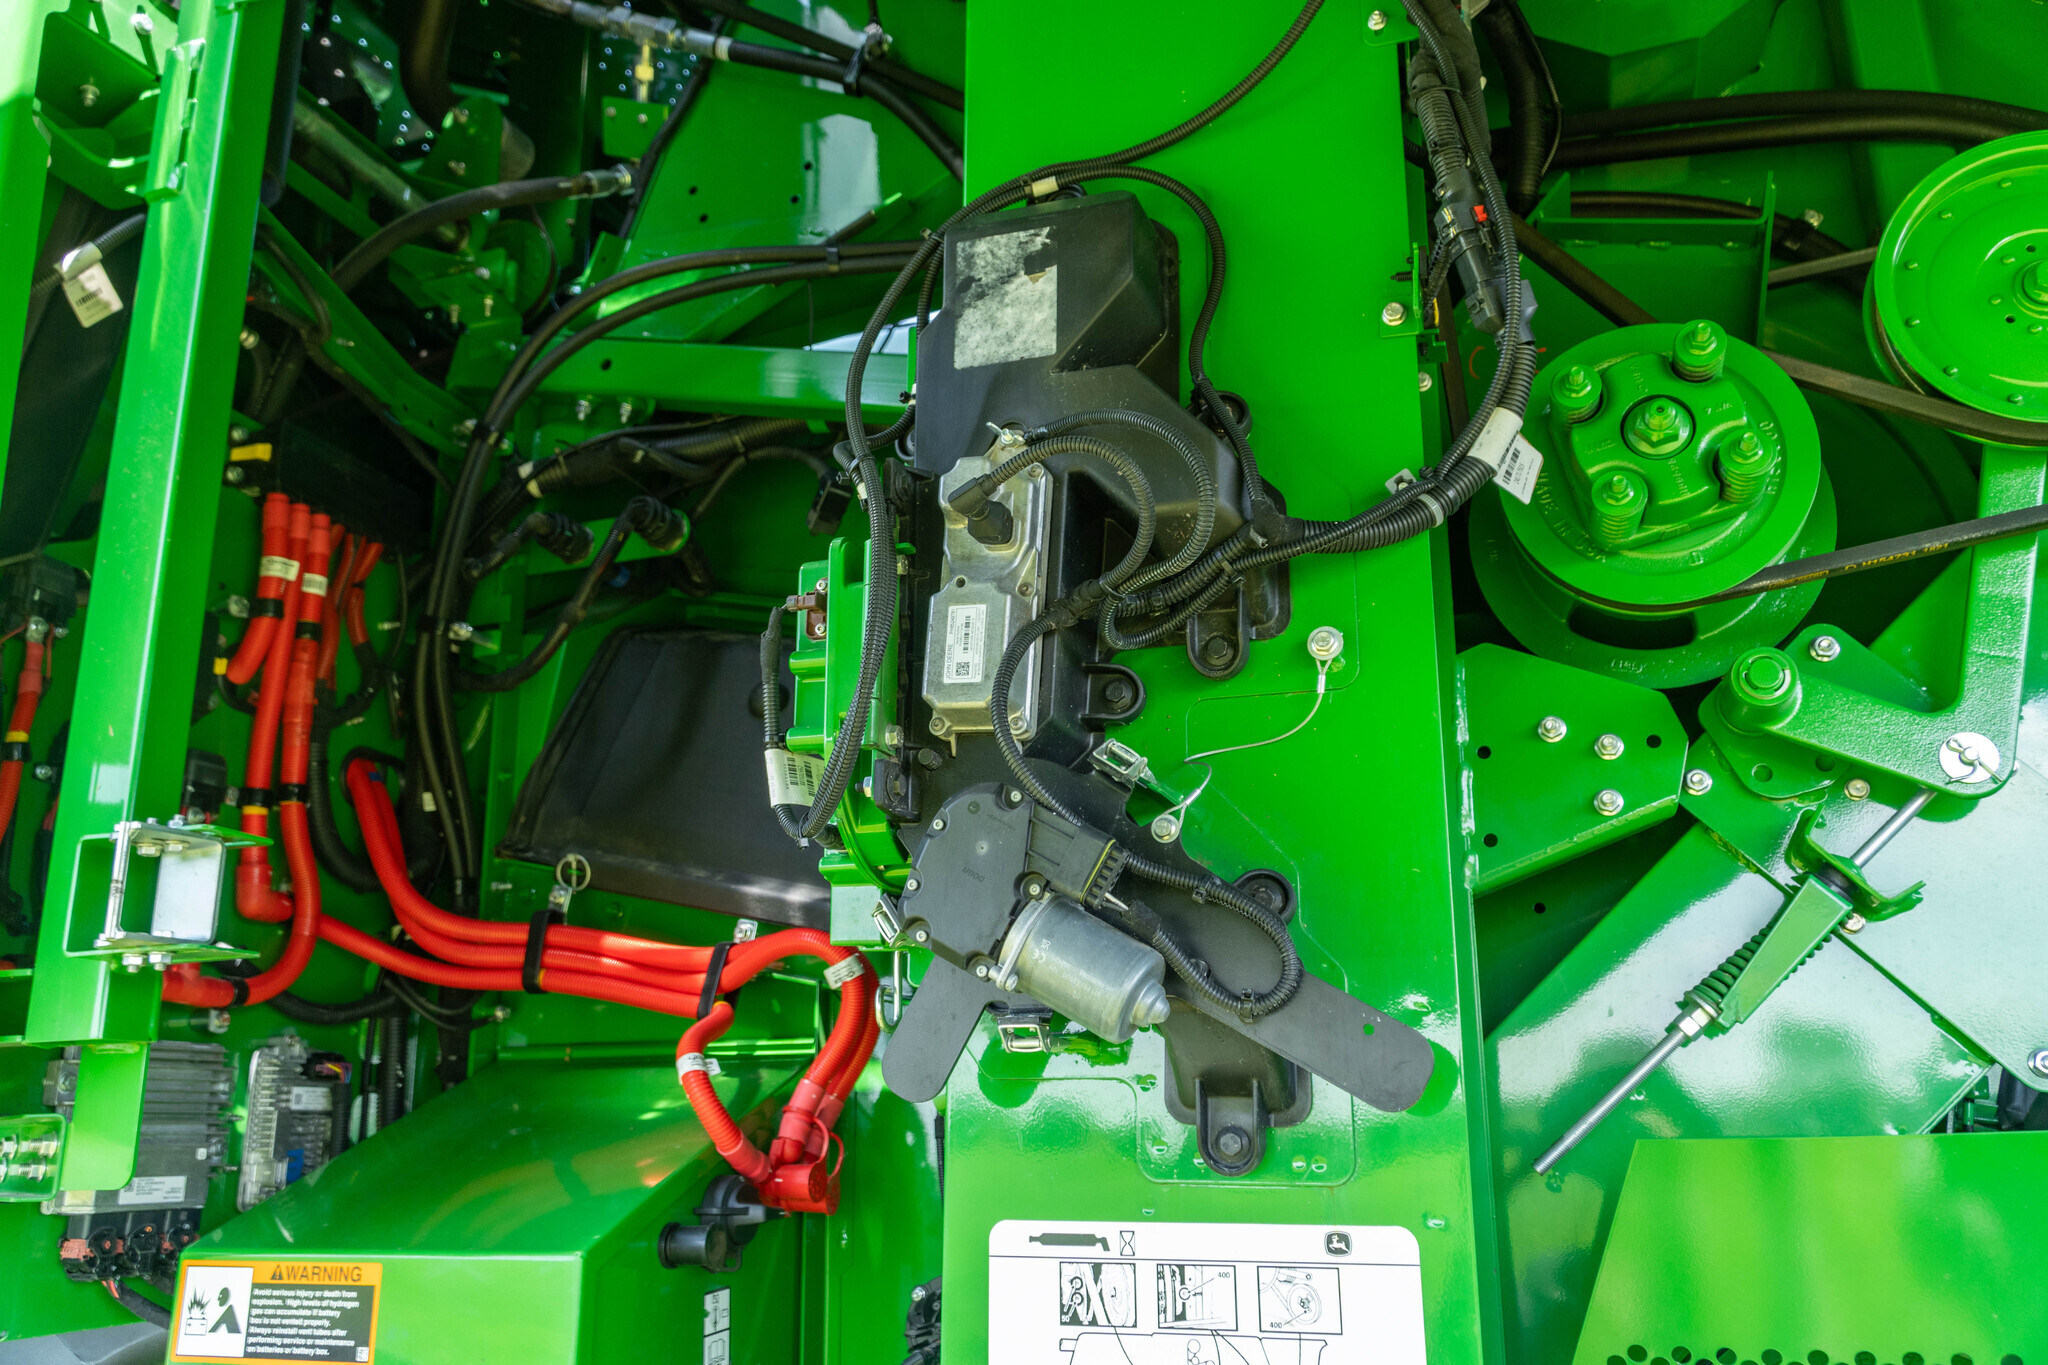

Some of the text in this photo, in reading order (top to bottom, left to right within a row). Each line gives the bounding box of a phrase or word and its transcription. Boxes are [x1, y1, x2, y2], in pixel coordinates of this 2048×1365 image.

[946, 643, 954, 664] DEERE
[286, 1265, 362, 1282] WARNING
[1217, 1271, 1231, 1279] 400
[253, 1288, 272, 1297] Avoid
[296, 1289, 314, 1298] injury
[323, 1290, 341, 1298] death
[342, 1290, 357, 1298] from
[251, 1298, 284, 1307] explosion.
[285, 1299, 302, 1307] High
[329, 1300, 360, 1309] hydrogen
[318, 1309, 341, 1318] battery
[249, 1316, 262, 1324] box
[303, 1319, 331, 1328] properly.
[1061, 1315, 1071, 1323] 50
[1269, 1321, 1283, 1329] 400
[248, 1326, 271, 1335] Always
[272, 1327, 298, 1335] reinstall
[313, 1328, 331, 1336] tubes
[246, 1336, 282, 1345] performing
[283, 1337, 306, 1345] service
[314, 1338, 356, 1347] maintenance
[256, 1345, 284, 1354] batteries
[292, 1347, 316, 1356] battery
[315, 1347, 330, 1355] box.
